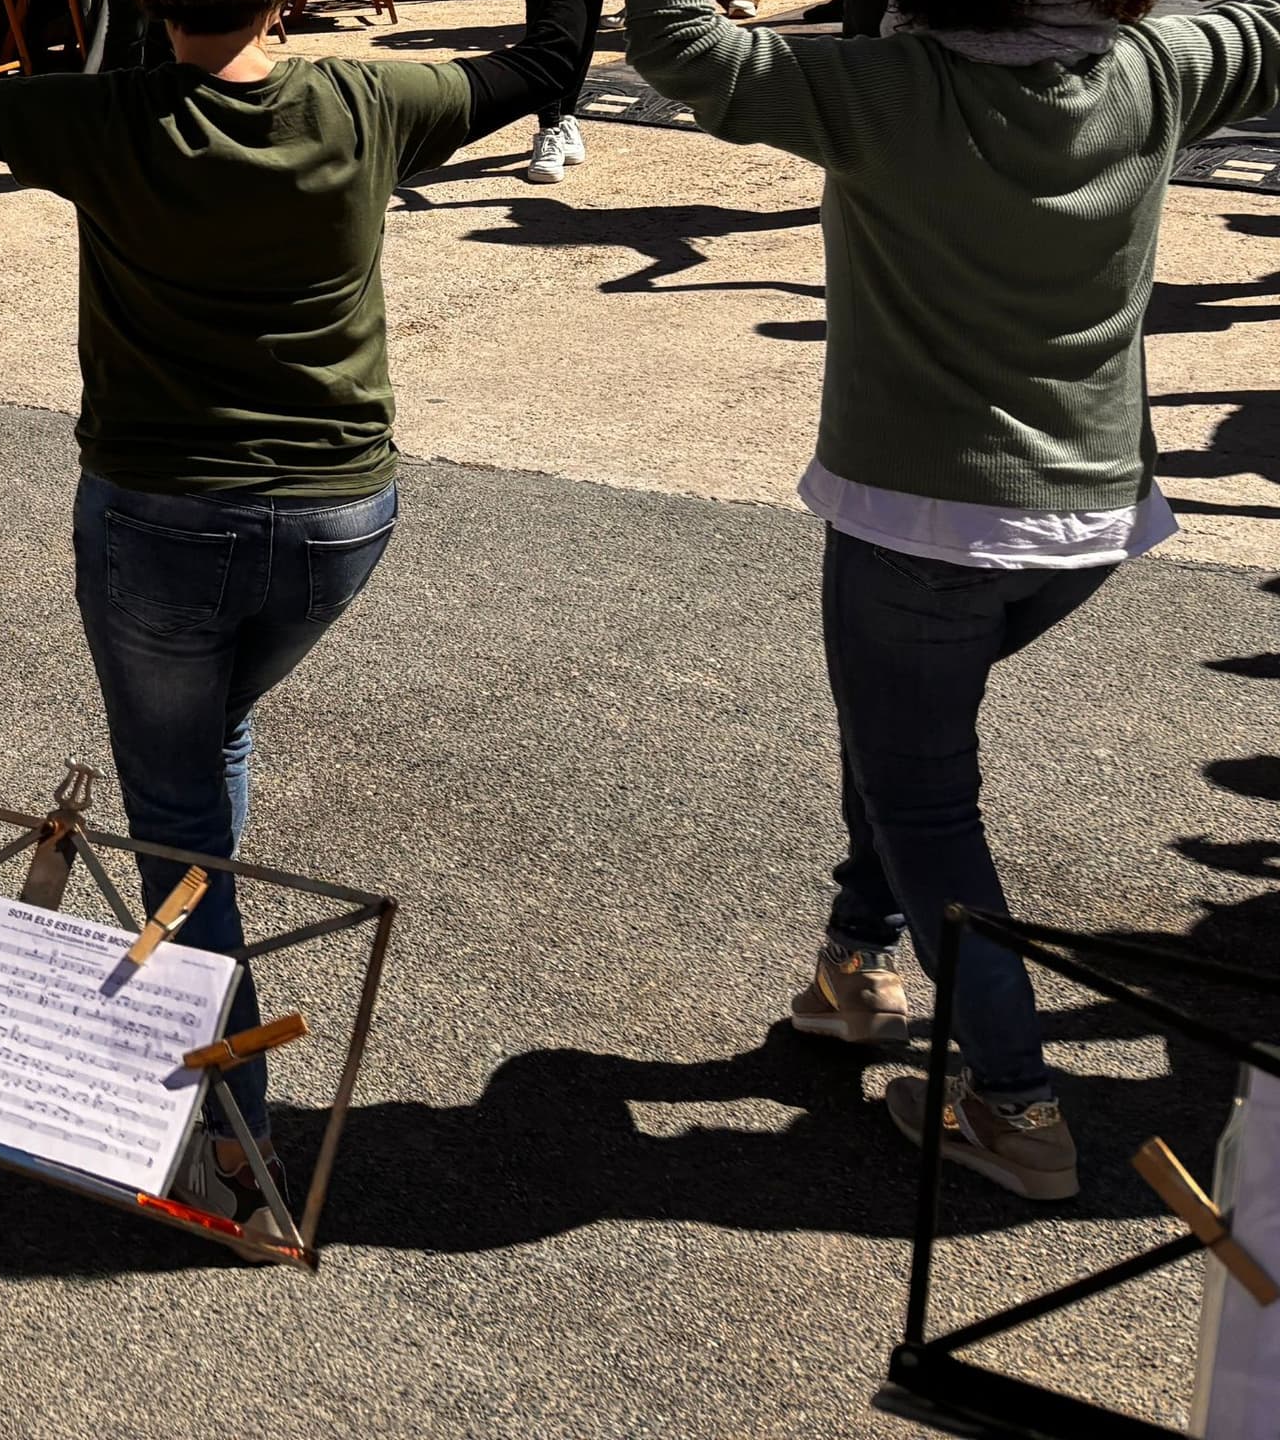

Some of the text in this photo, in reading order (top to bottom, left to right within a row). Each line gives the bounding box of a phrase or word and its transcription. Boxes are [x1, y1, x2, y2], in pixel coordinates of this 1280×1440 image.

[7, 908, 33, 921] SOTA
[34, 916, 54, 927] ELS
[54, 919, 92, 938] ESTELS
[92, 930, 107, 941] DE
